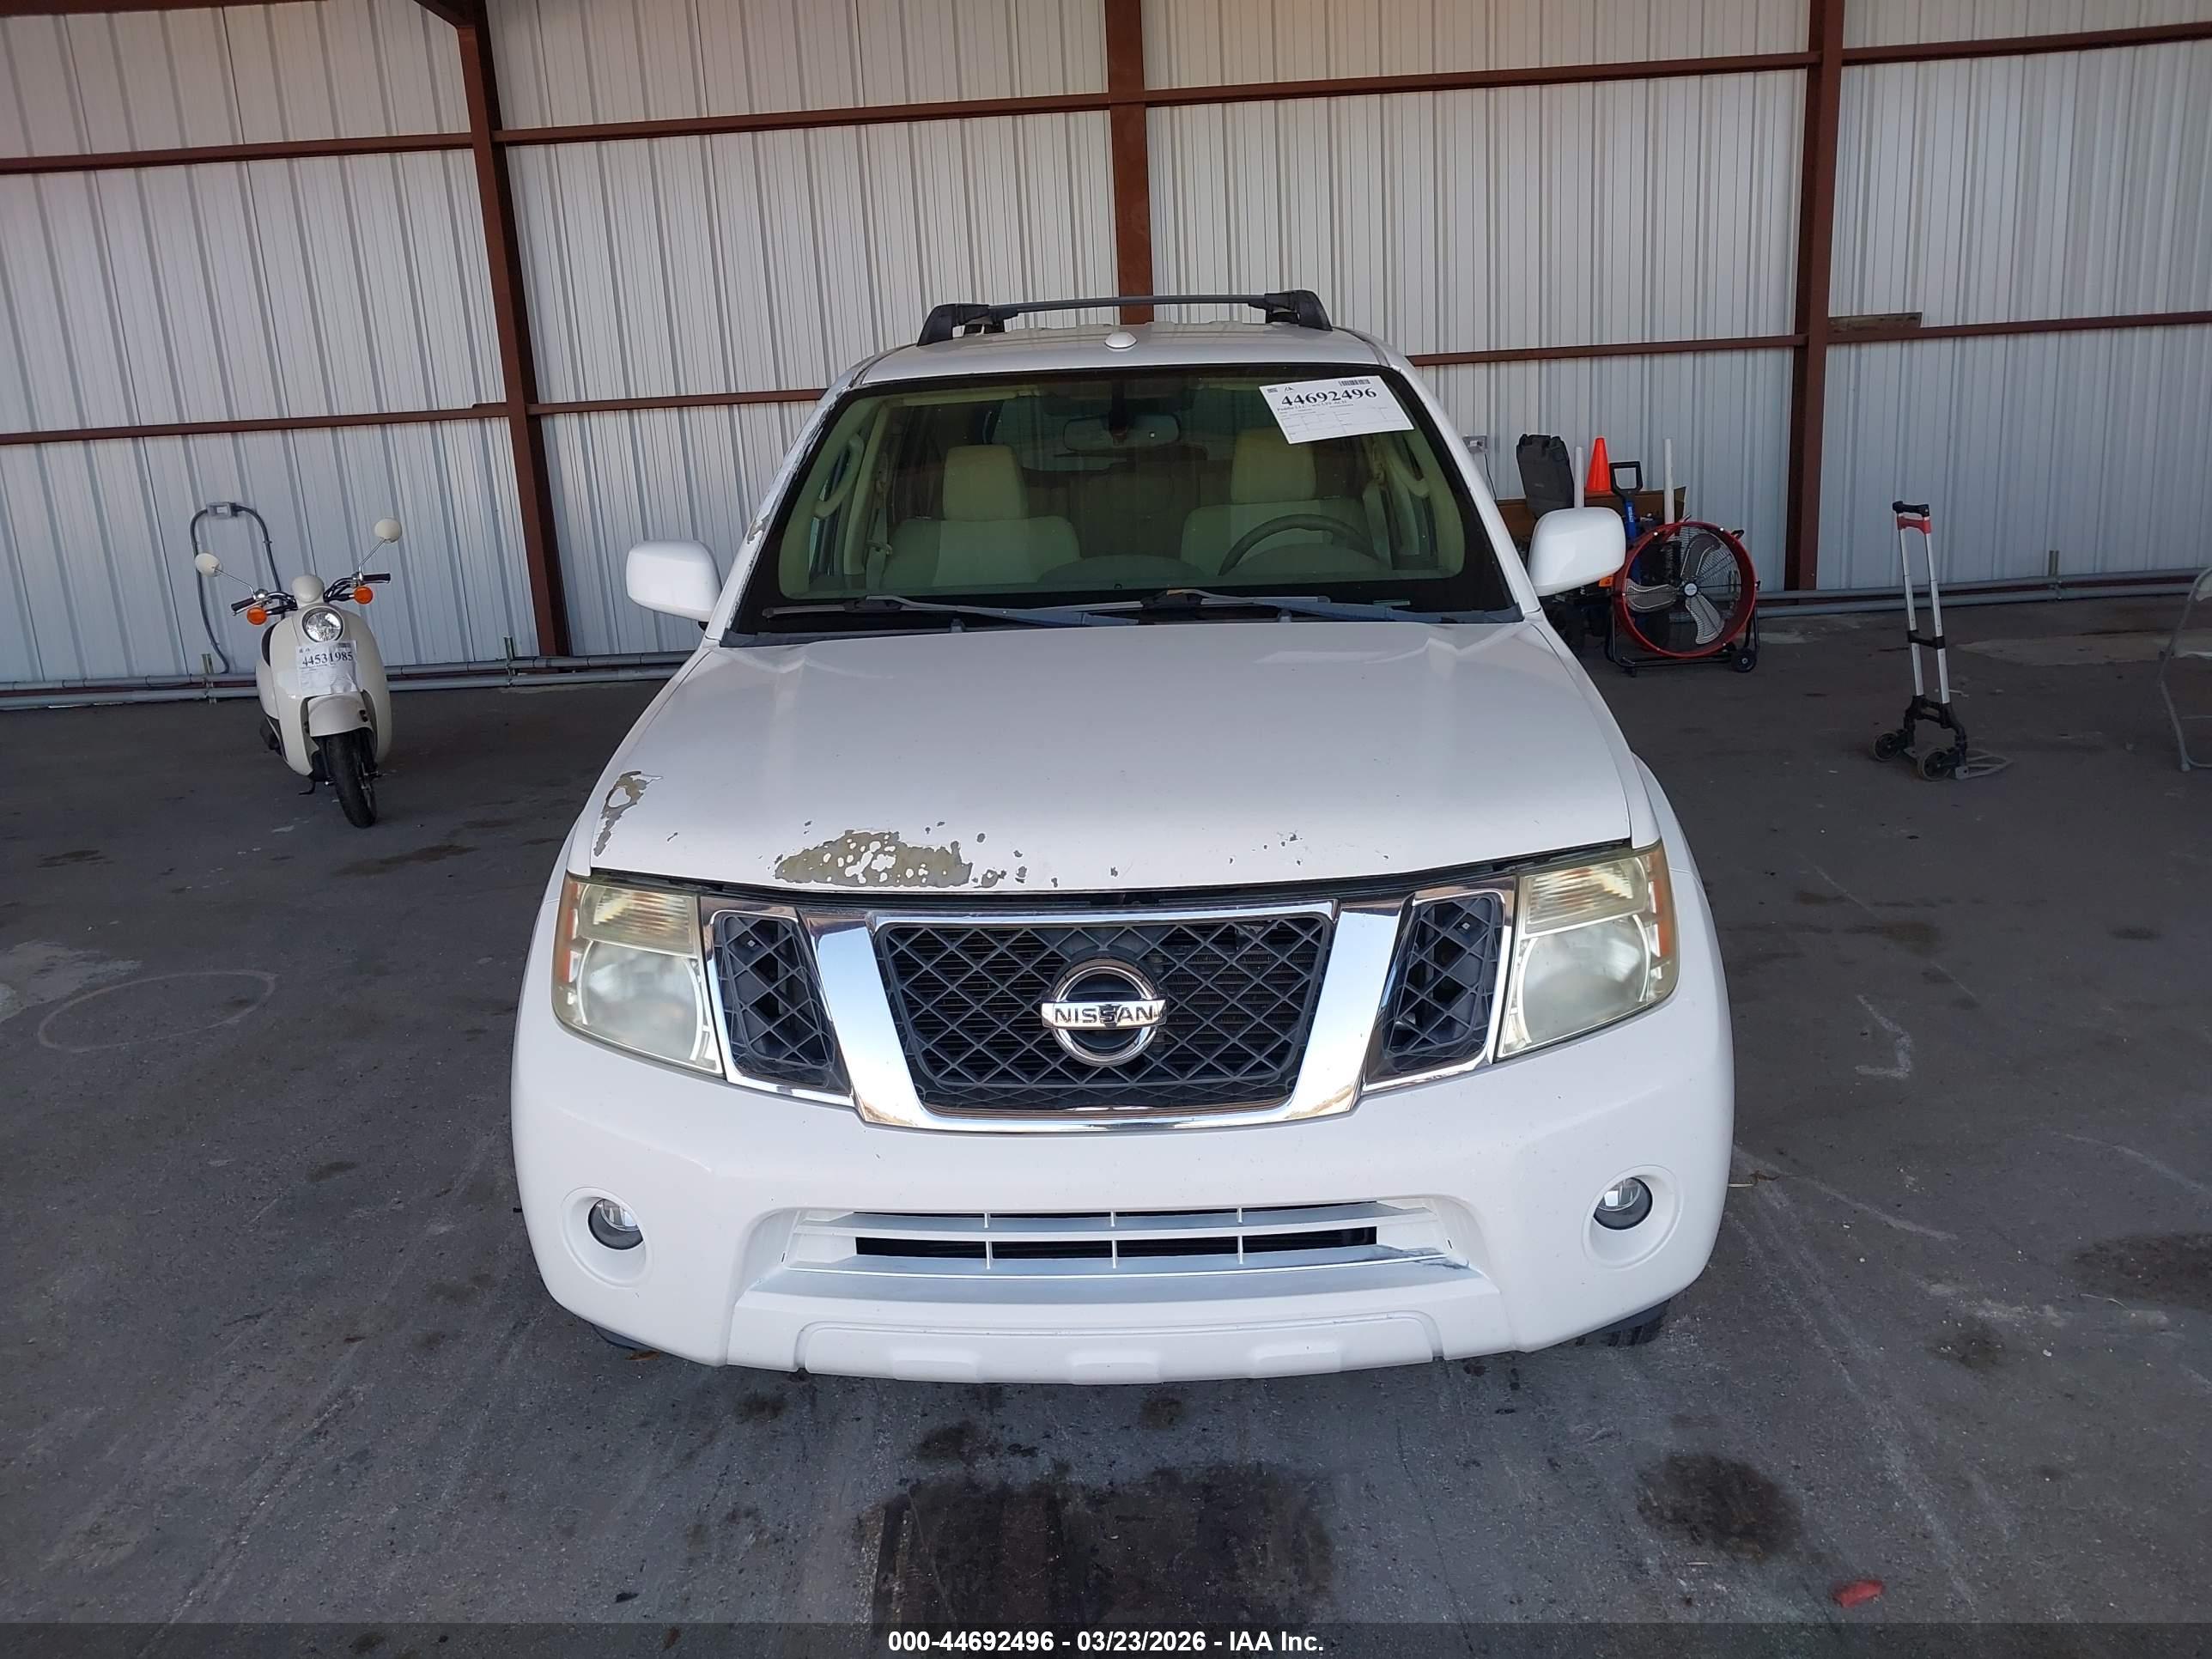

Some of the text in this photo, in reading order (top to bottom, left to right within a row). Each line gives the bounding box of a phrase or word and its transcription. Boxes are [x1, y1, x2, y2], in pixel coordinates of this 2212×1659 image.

[1281, 387, 1377, 407] 44692496
[302, 652, 354, 666] 44531985
[1054, 1005, 1153, 1024] NISSAN
